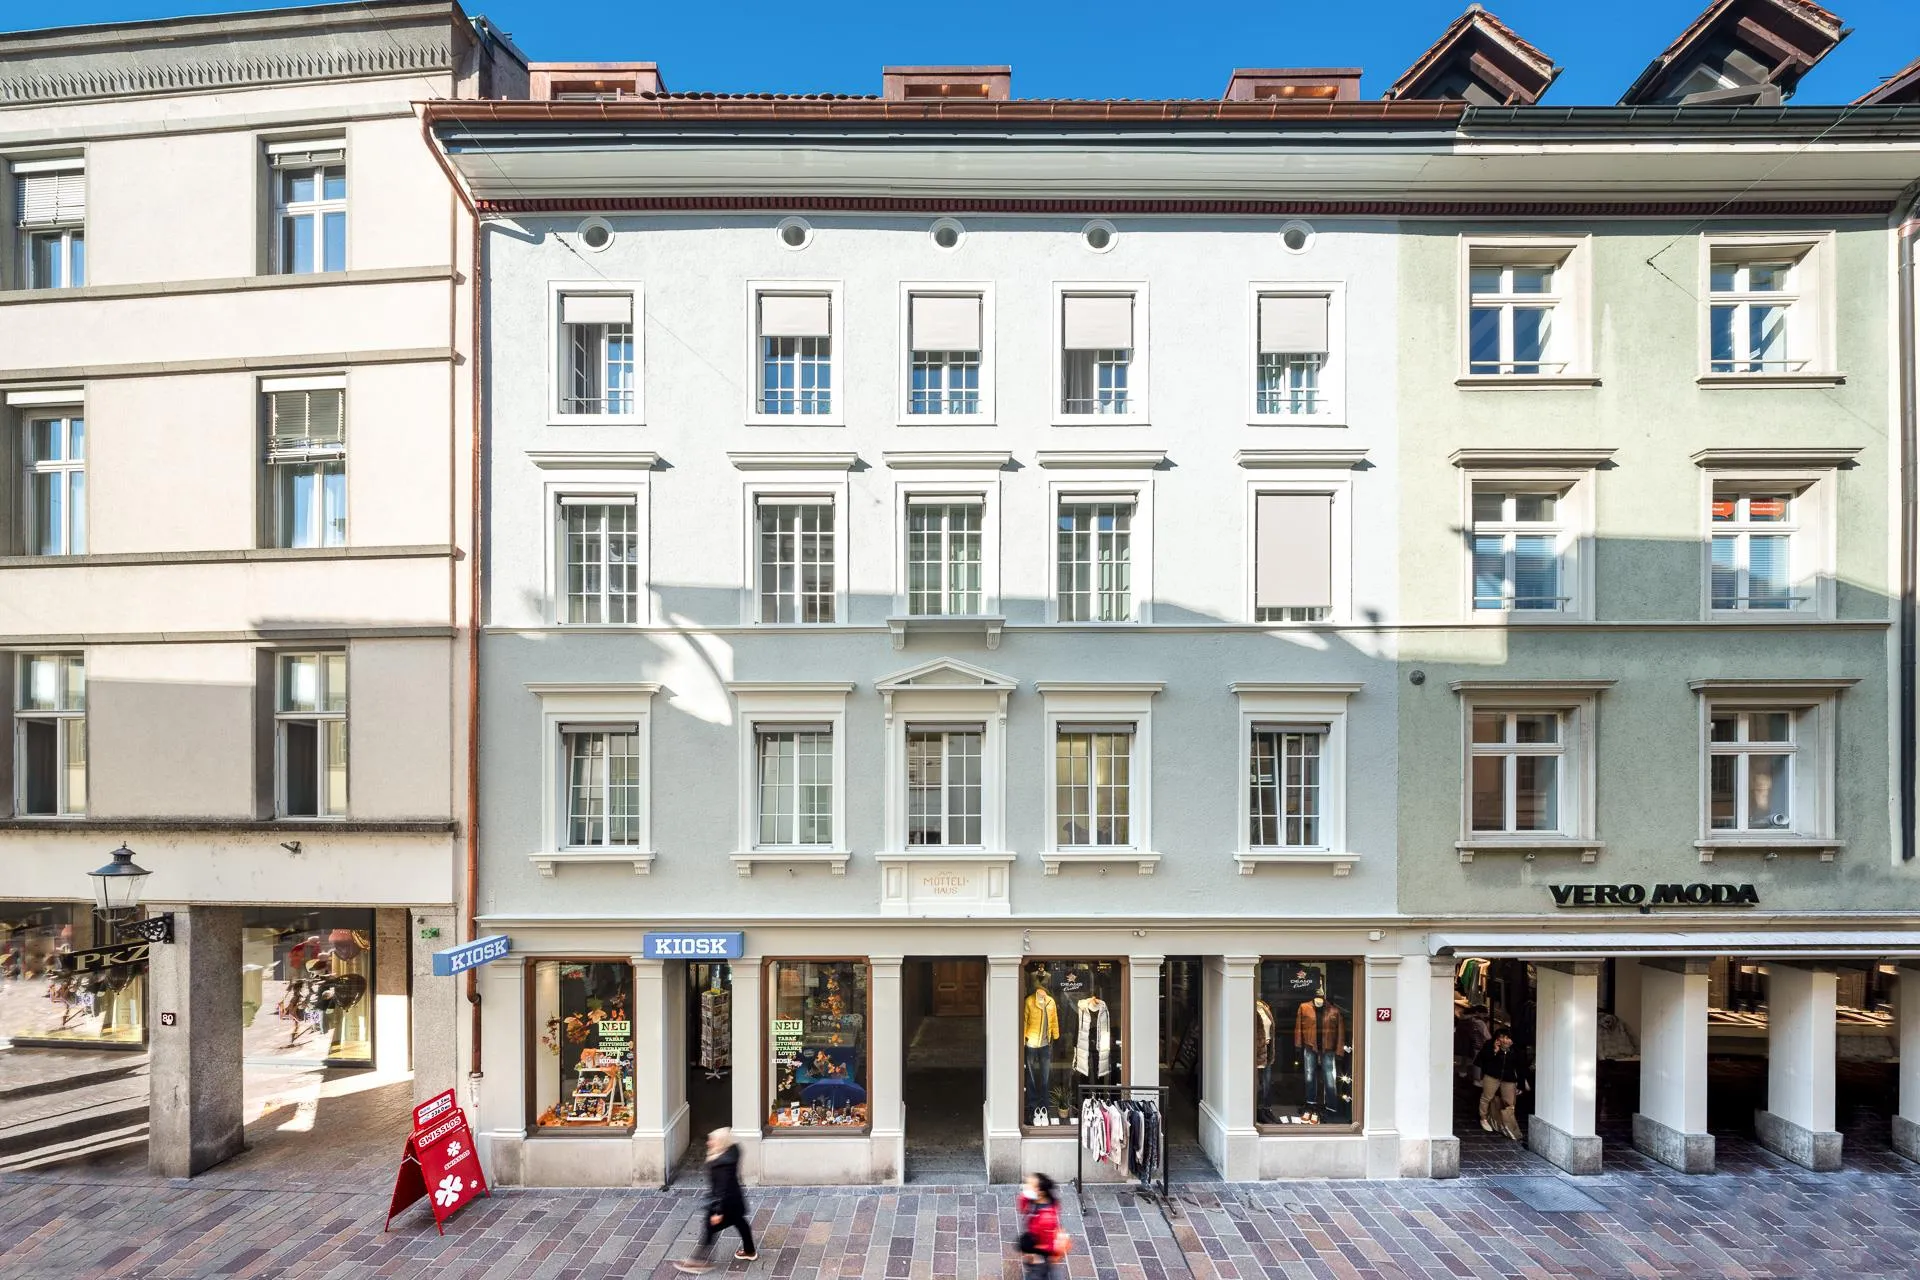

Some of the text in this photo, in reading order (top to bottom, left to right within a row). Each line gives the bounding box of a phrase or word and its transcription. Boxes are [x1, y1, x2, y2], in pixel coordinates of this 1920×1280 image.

[934, 887, 959, 895] HAUS
[1549, 883, 1761, 904] VERO MODA
[655, 938, 727, 955] KIOSK
[73, 944, 149, 971] PKZ
[450, 939, 507, 972] KIOSK
[162, 1014, 174, 1024] 80
[1378, 1009, 1390, 1018] 78
[601, 1022, 628, 1031] NEU
[775, 1021, 801, 1030] NEU
[419, 1117, 461, 1147] SWISSLOS
[445, 1150, 470, 1170] SWISSLOS
